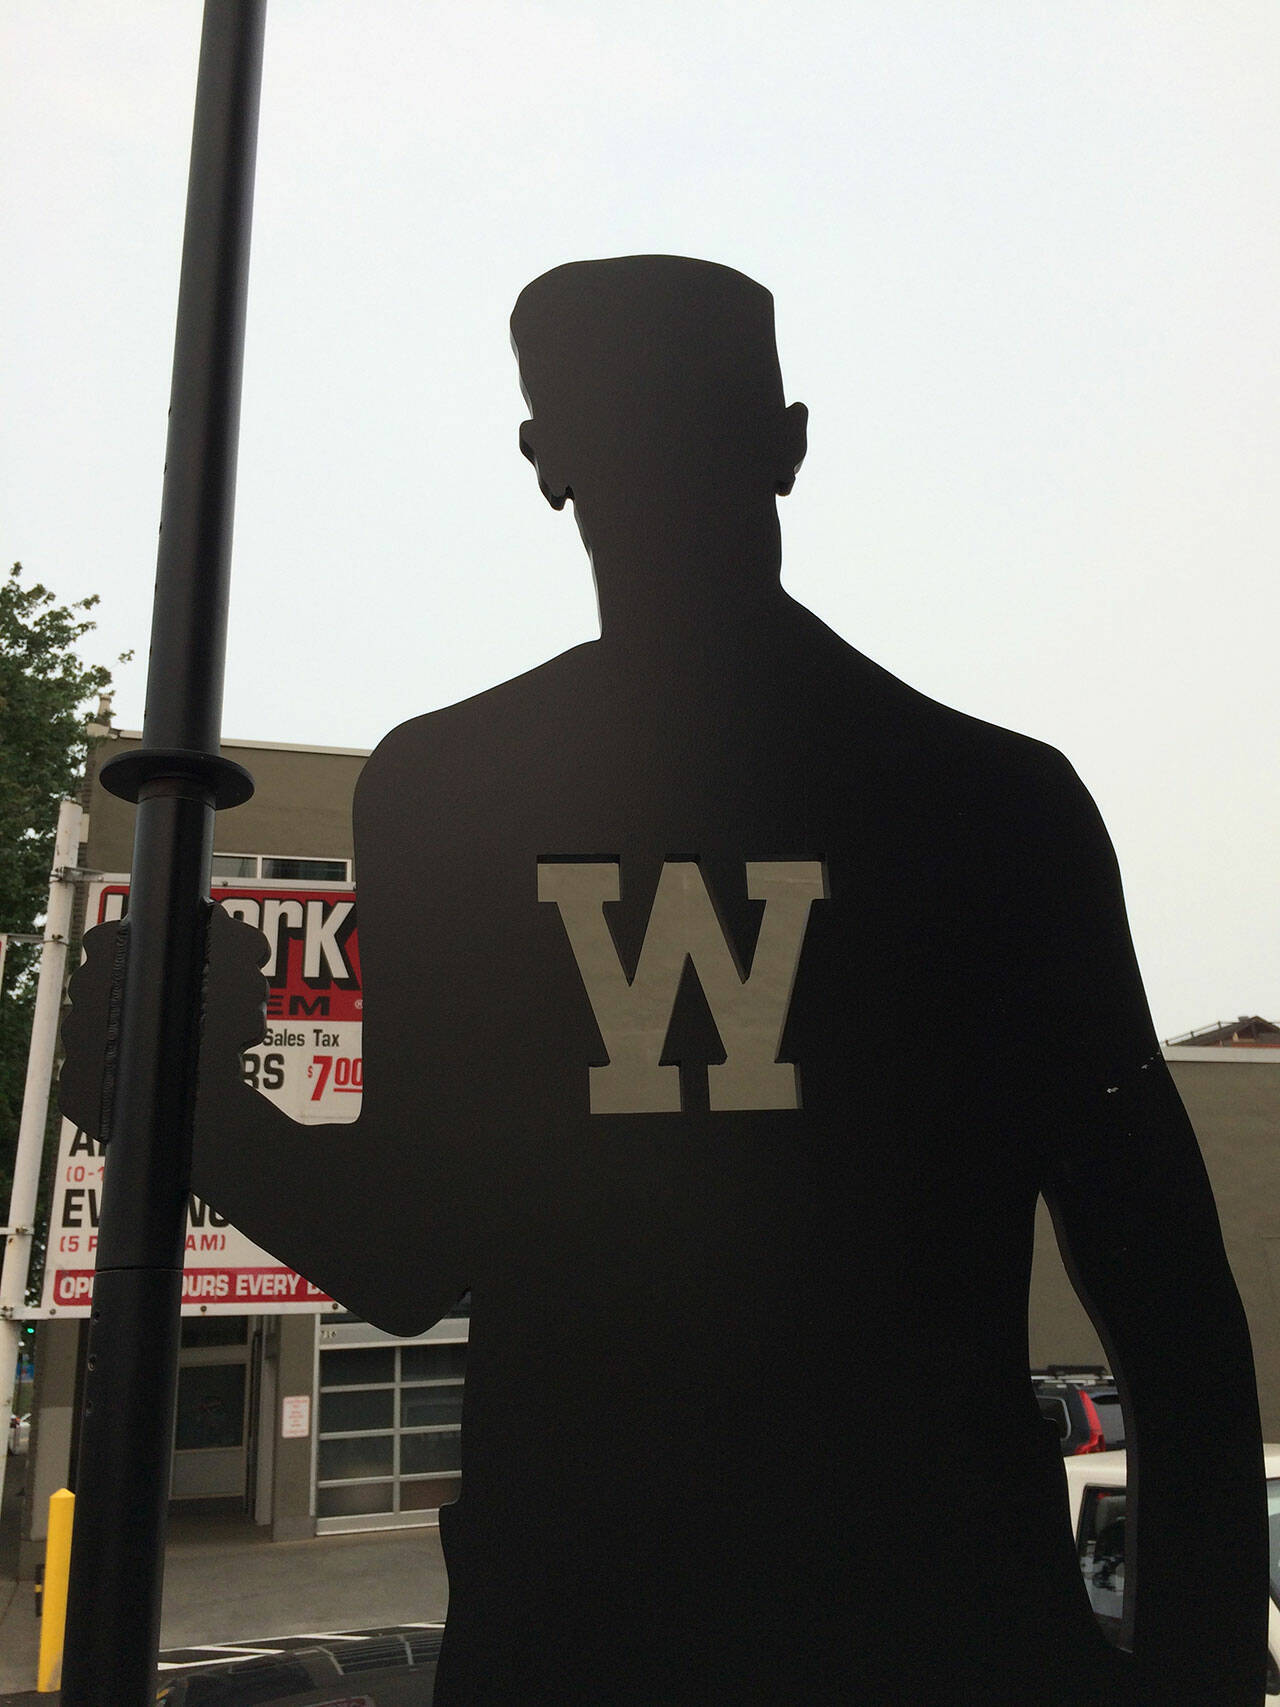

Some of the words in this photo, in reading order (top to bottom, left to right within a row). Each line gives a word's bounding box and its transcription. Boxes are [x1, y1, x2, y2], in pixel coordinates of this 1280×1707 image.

[537, 861, 825, 1115] W
[263, 1028, 305, 1047] Sales
[313, 1029, 340, 1047] Tax
[236, 1274, 301, 1295] EVERY
